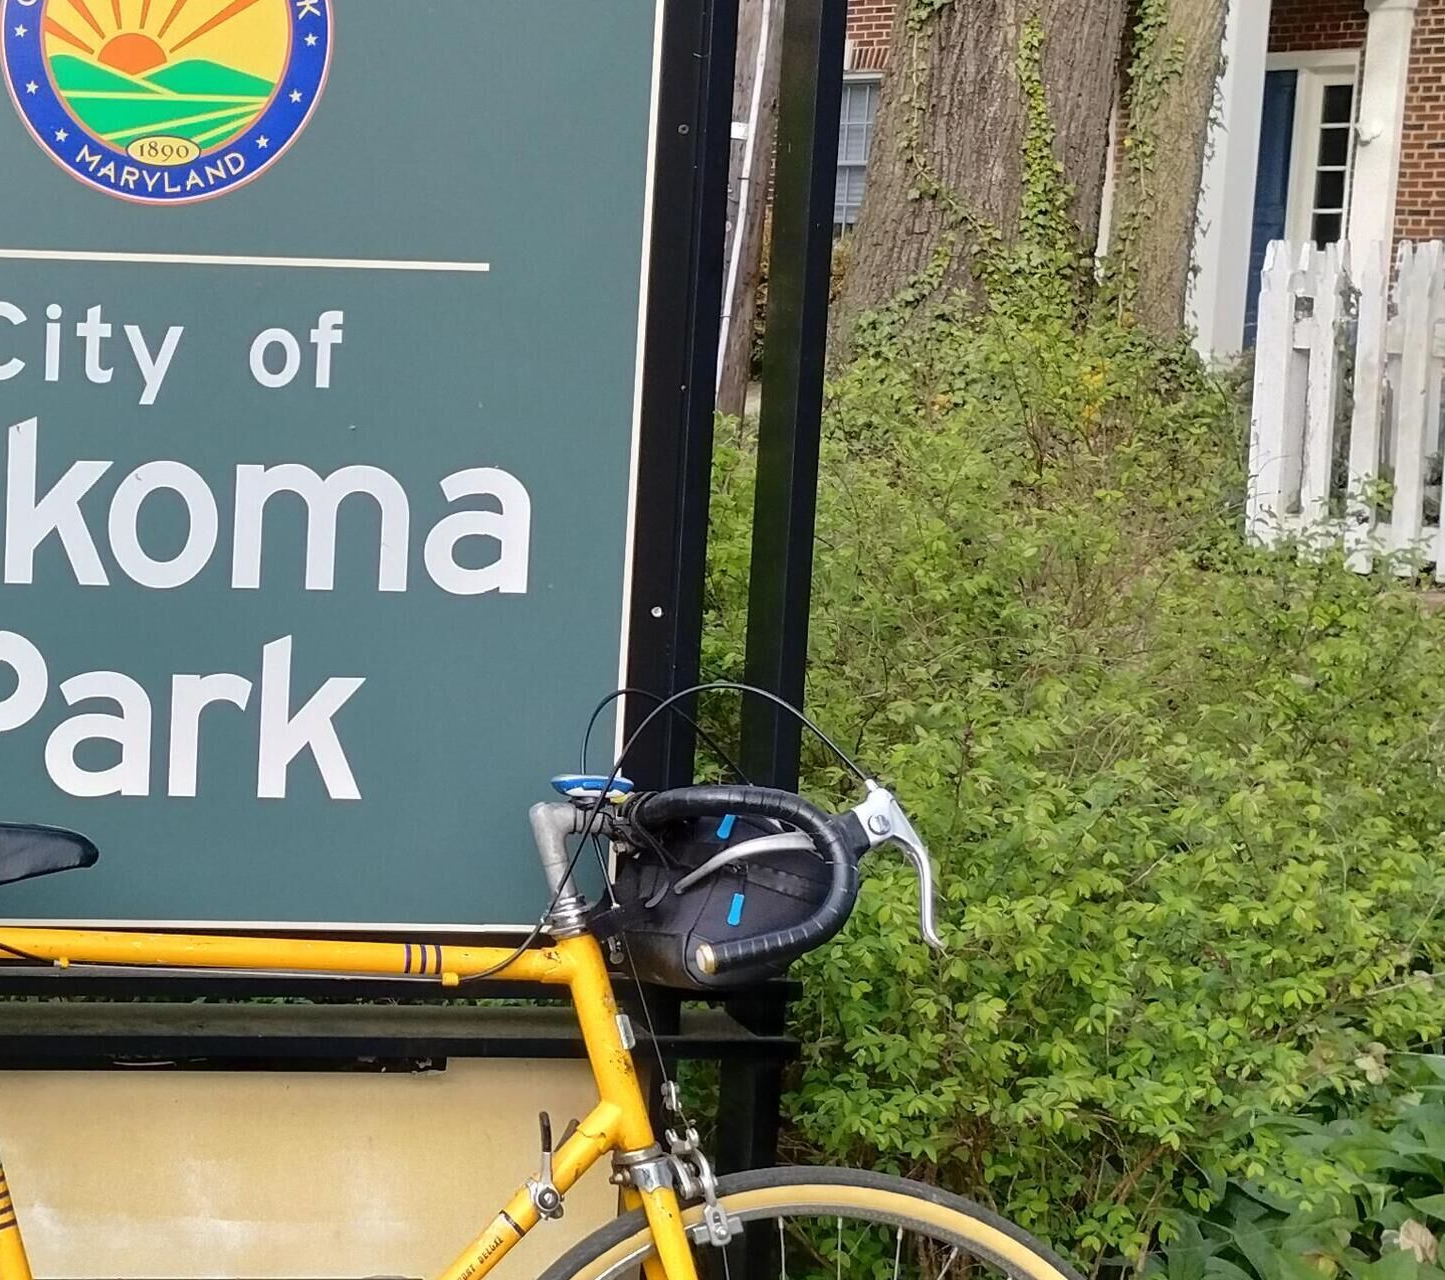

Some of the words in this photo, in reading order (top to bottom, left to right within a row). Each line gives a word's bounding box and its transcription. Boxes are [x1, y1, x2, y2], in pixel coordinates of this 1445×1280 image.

[75, 144, 246, 193] MARYLAND
[138, 144, 190, 162] 1890
[249, 310, 344, 389] of
